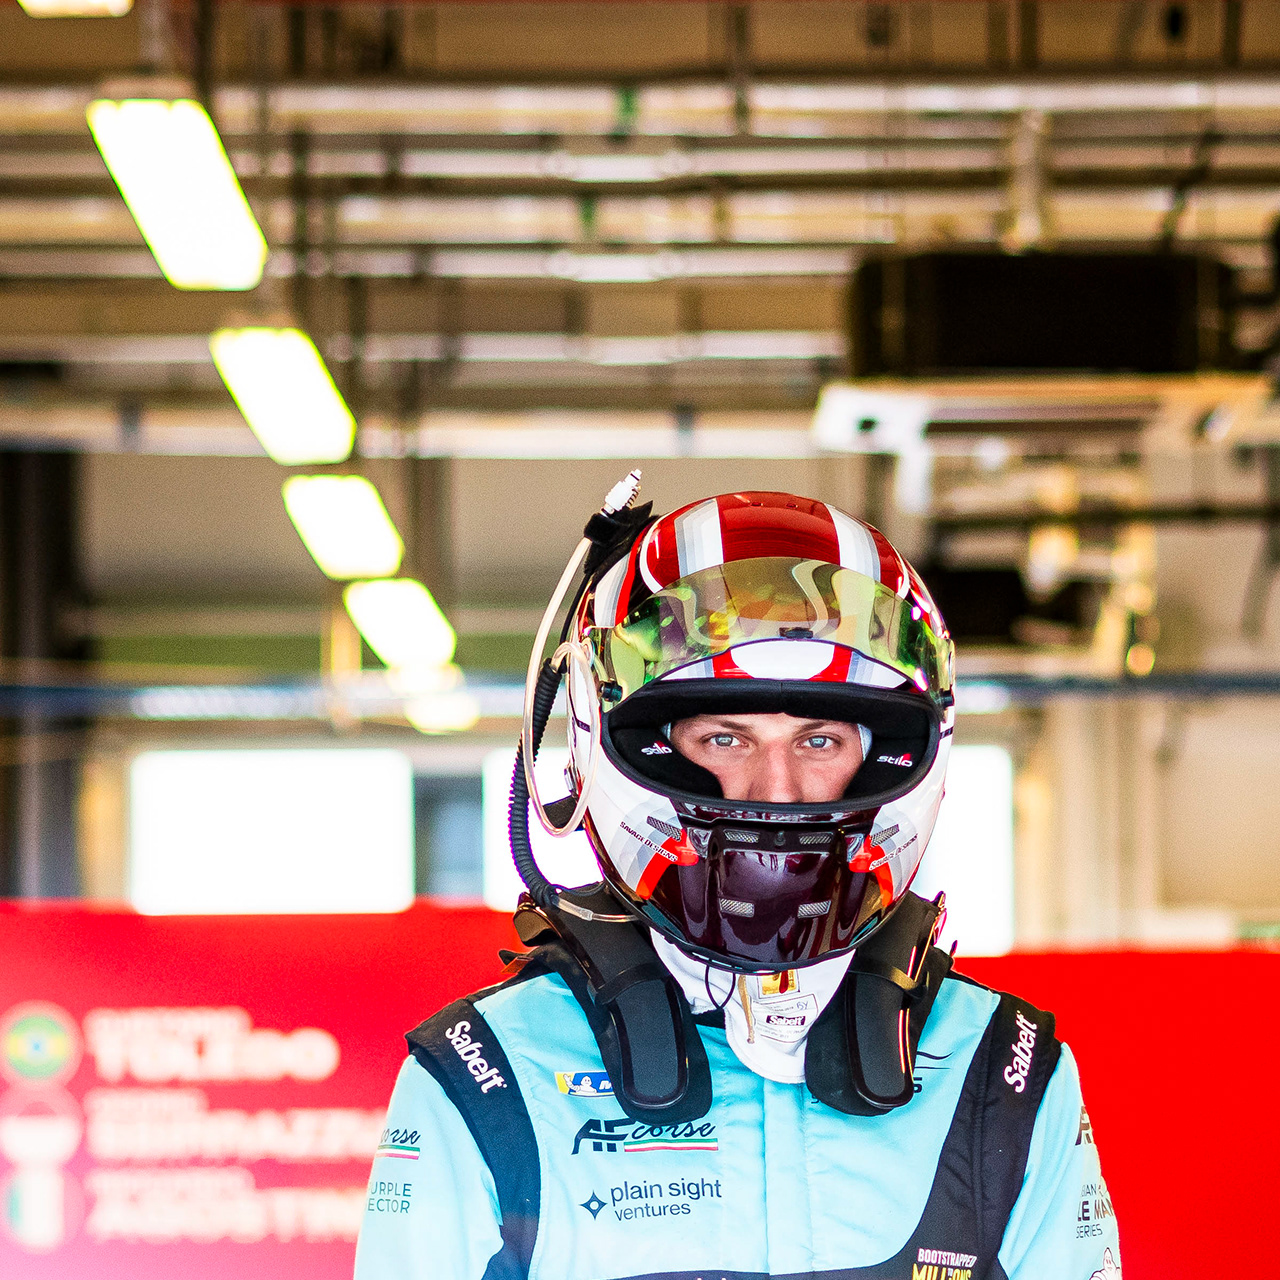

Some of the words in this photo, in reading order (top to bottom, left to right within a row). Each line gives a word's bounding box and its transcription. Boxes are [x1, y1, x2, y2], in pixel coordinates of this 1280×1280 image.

[877, 755, 913, 767] stilo
[445, 1021, 506, 1093] Sabelt
[1003, 1012, 1037, 1093] Sabelt
[631, 1121, 716, 1139] corse
[370, 1182, 412, 1197] URPLE
[610, 1180, 663, 1207] plain
[668, 1177, 722, 1200] sight
[368, 1198, 410, 1213] ECTOR
[614, 1202, 691, 1221] ventures
[918, 1248, 978, 1268] BOOTSTRAPPED
